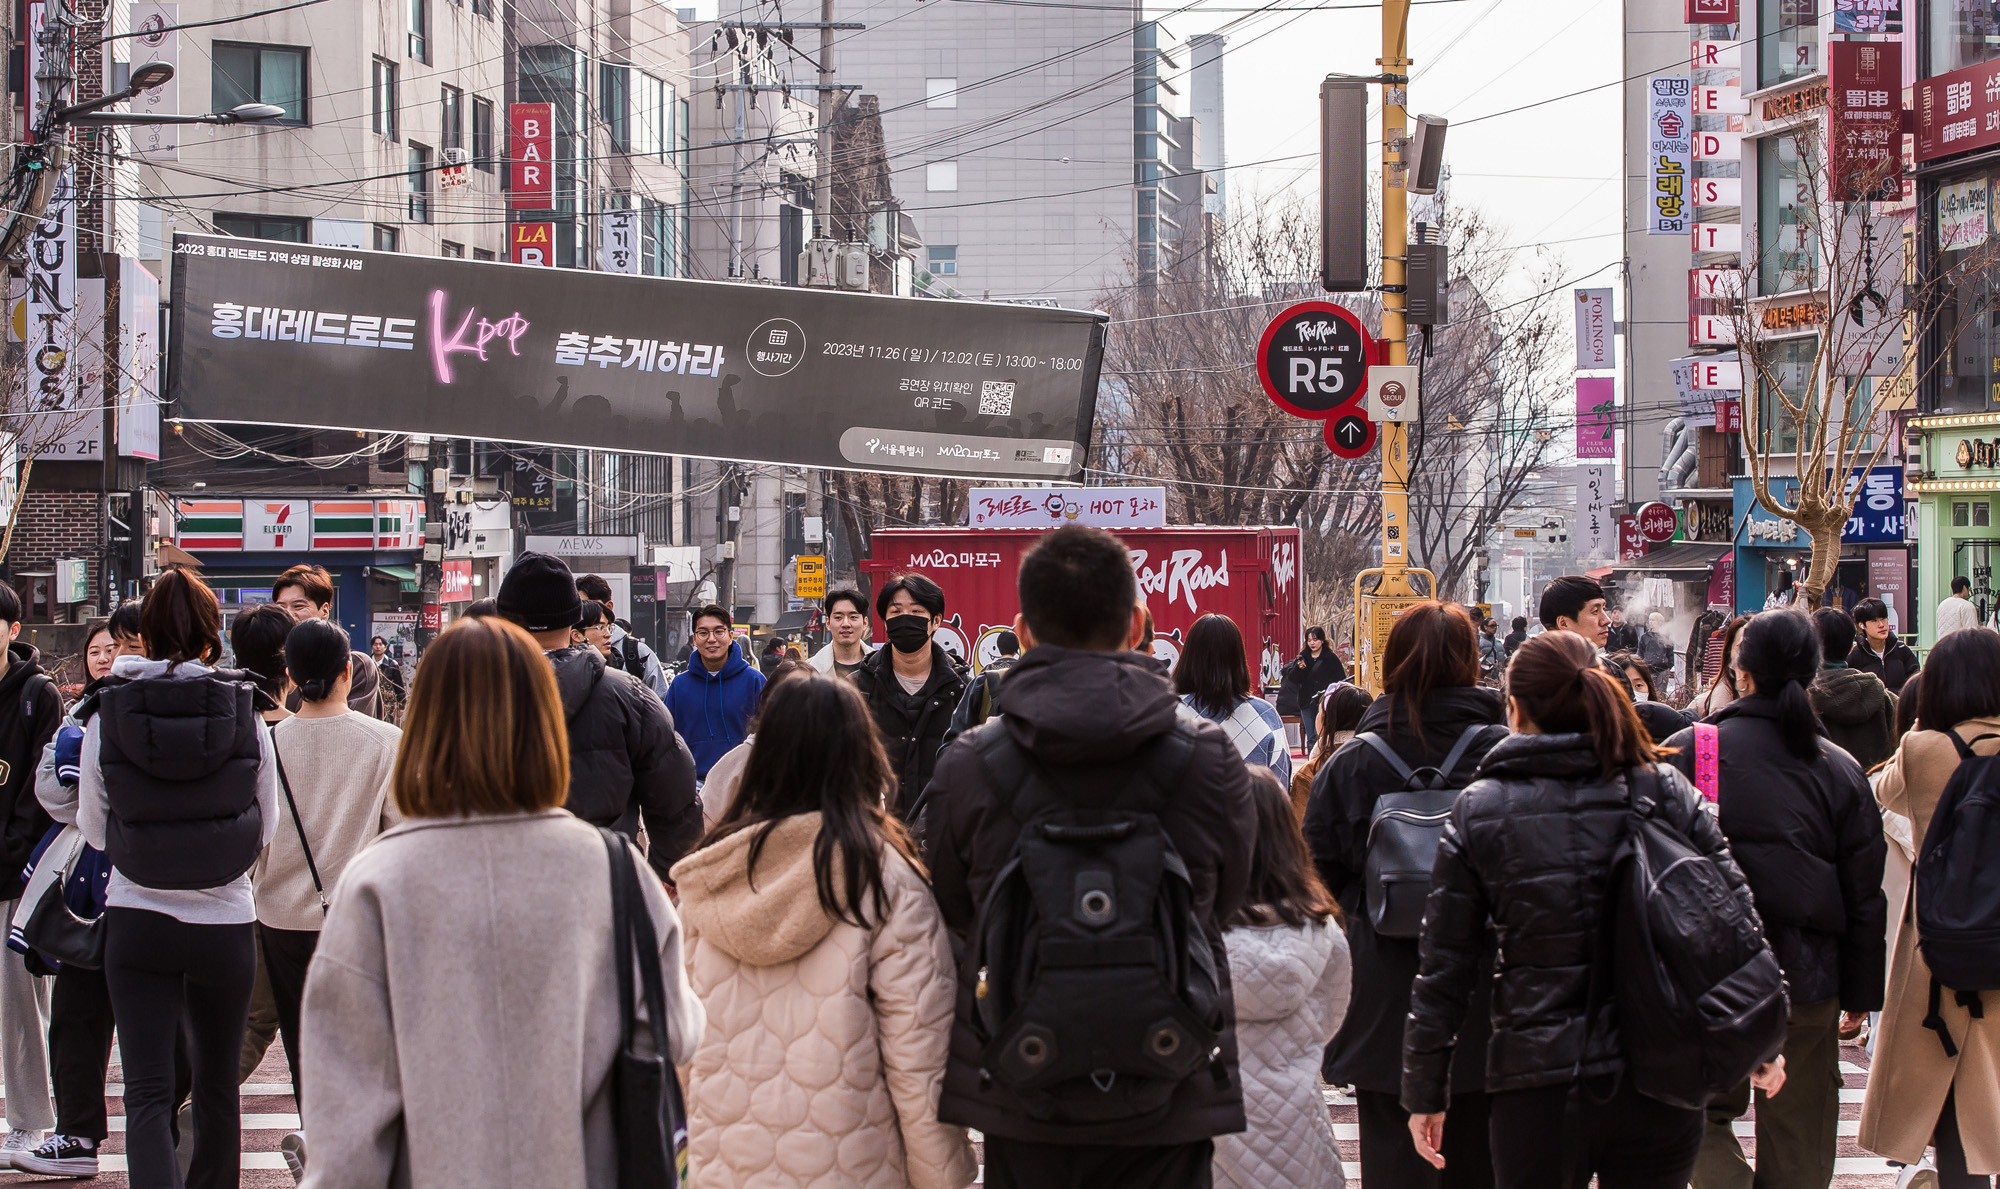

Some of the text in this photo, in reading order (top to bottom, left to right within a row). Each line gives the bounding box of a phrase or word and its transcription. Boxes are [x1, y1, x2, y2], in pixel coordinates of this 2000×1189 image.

[1856, 15, 1881, 28] 3F
[1653, 79, 1688, 96] 웰빙
[1846, 90, 1888, 107] 蜀串
[1946, 81, 1972, 116] 蜀串
[1658, 110, 1683, 138] 술
[523, 119, 540, 185] BAR
[1653, 140, 1689, 153] 마시는
[1656, 155, 1685, 217] 노래방
[1659, 219, 1682, 231] B1
[516, 226, 548, 243] LA
[177, 243, 363, 271] 2023 홍대 레드로드 지역 상권 활성화 사업
[1592, 297, 1604, 363] POKING94
[211, 301, 416, 351] 홍대레드로드
[555, 331, 725, 378] 춤추게하라
[756, 350, 793, 364] 행사기간
[823, 342, 865, 358] 2023년
[869, 346, 900, 360] 11.26
[941, 351, 973, 365] 12.02
[1005, 355, 1037, 368] 13:00
[1050, 357, 1082, 371] 18:00
[1888, 356, 1897, 364] B1
[1289, 357, 1344, 393] R5
[899, 378, 974, 395] 공연장 위치확인
[914, 396, 953, 410] QR 코드
[76, 440, 98, 454] 2F
[880, 443, 924, 457] 서울특별시
[973, 449, 1000, 461] 마포구
[1578, 446, 1613, 454] HAVANA
[537, 497, 551, 506] 소주
[1090, 500, 1125, 515] HOT
[1129, 497, 1158, 518] 포차
[1588, 467, 1602, 535] 네일싸롱
[1643, 516, 1674, 533] 피냉면
[558, 537, 603, 550] MEWS
[960, 552, 1001, 568] 마포구
[446, 570, 463, 593] BAR
[1168, 548, 1229, 614] Road
